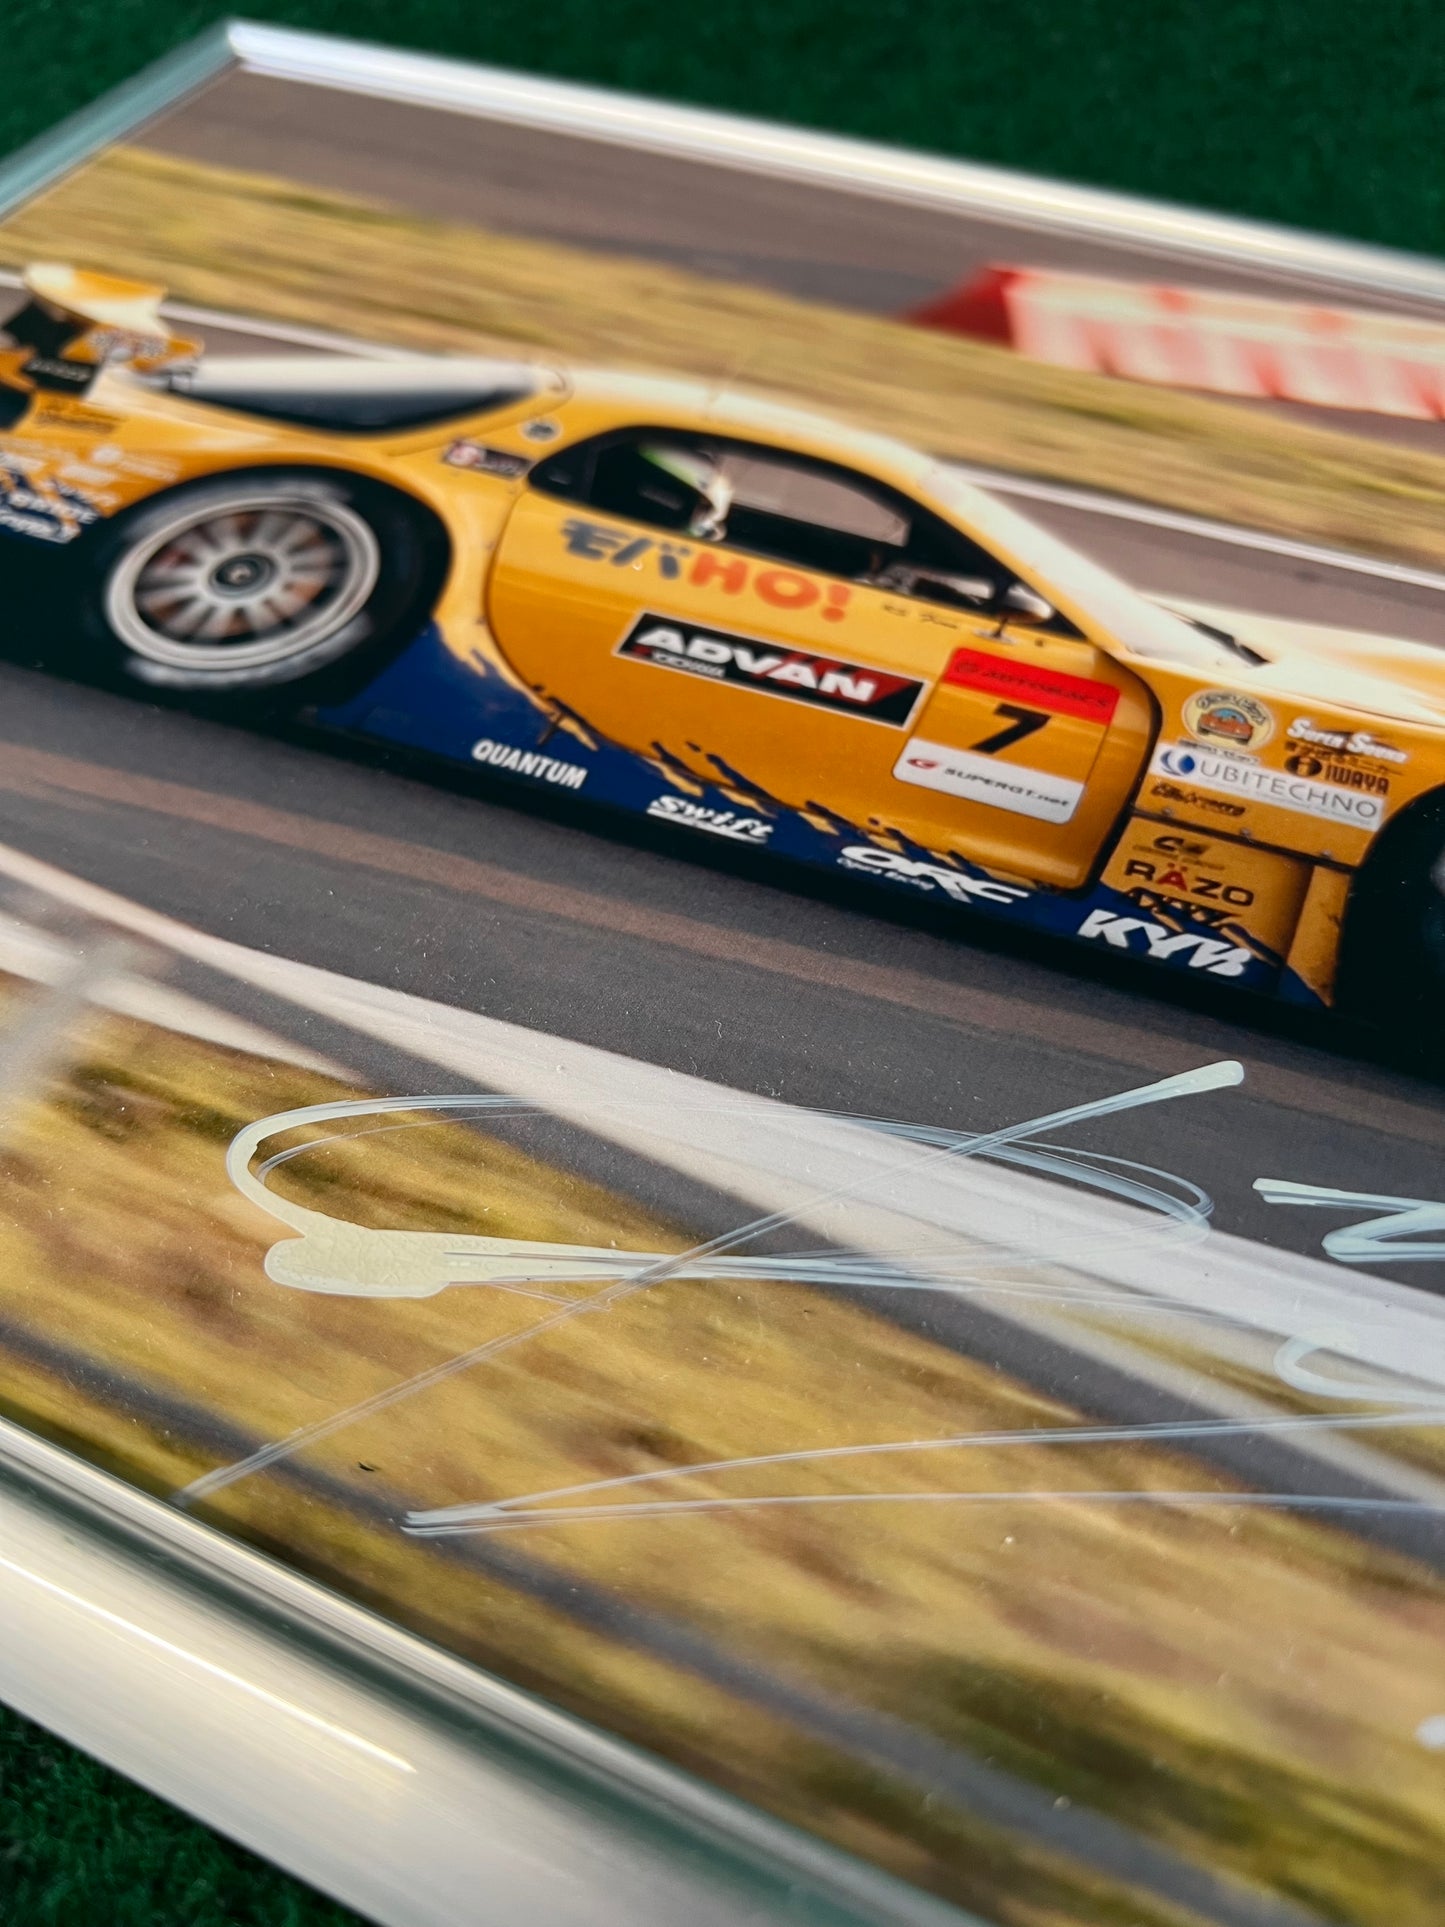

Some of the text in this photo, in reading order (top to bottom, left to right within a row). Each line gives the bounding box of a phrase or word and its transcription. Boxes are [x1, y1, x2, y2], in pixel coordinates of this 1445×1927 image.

[635, 626, 878, 703] ADVAN
[969, 702, 1053, 755] 7
[471, 738, 589, 790] QUANTUM
[1200, 759, 1379, 819] UBITECHNO
[1324, 764, 1391, 795] IWAYA
[839, 845, 1030, 904] ORC
[1123, 861, 1255, 907] RÄZO
[1077, 908, 1252, 977] KYB
